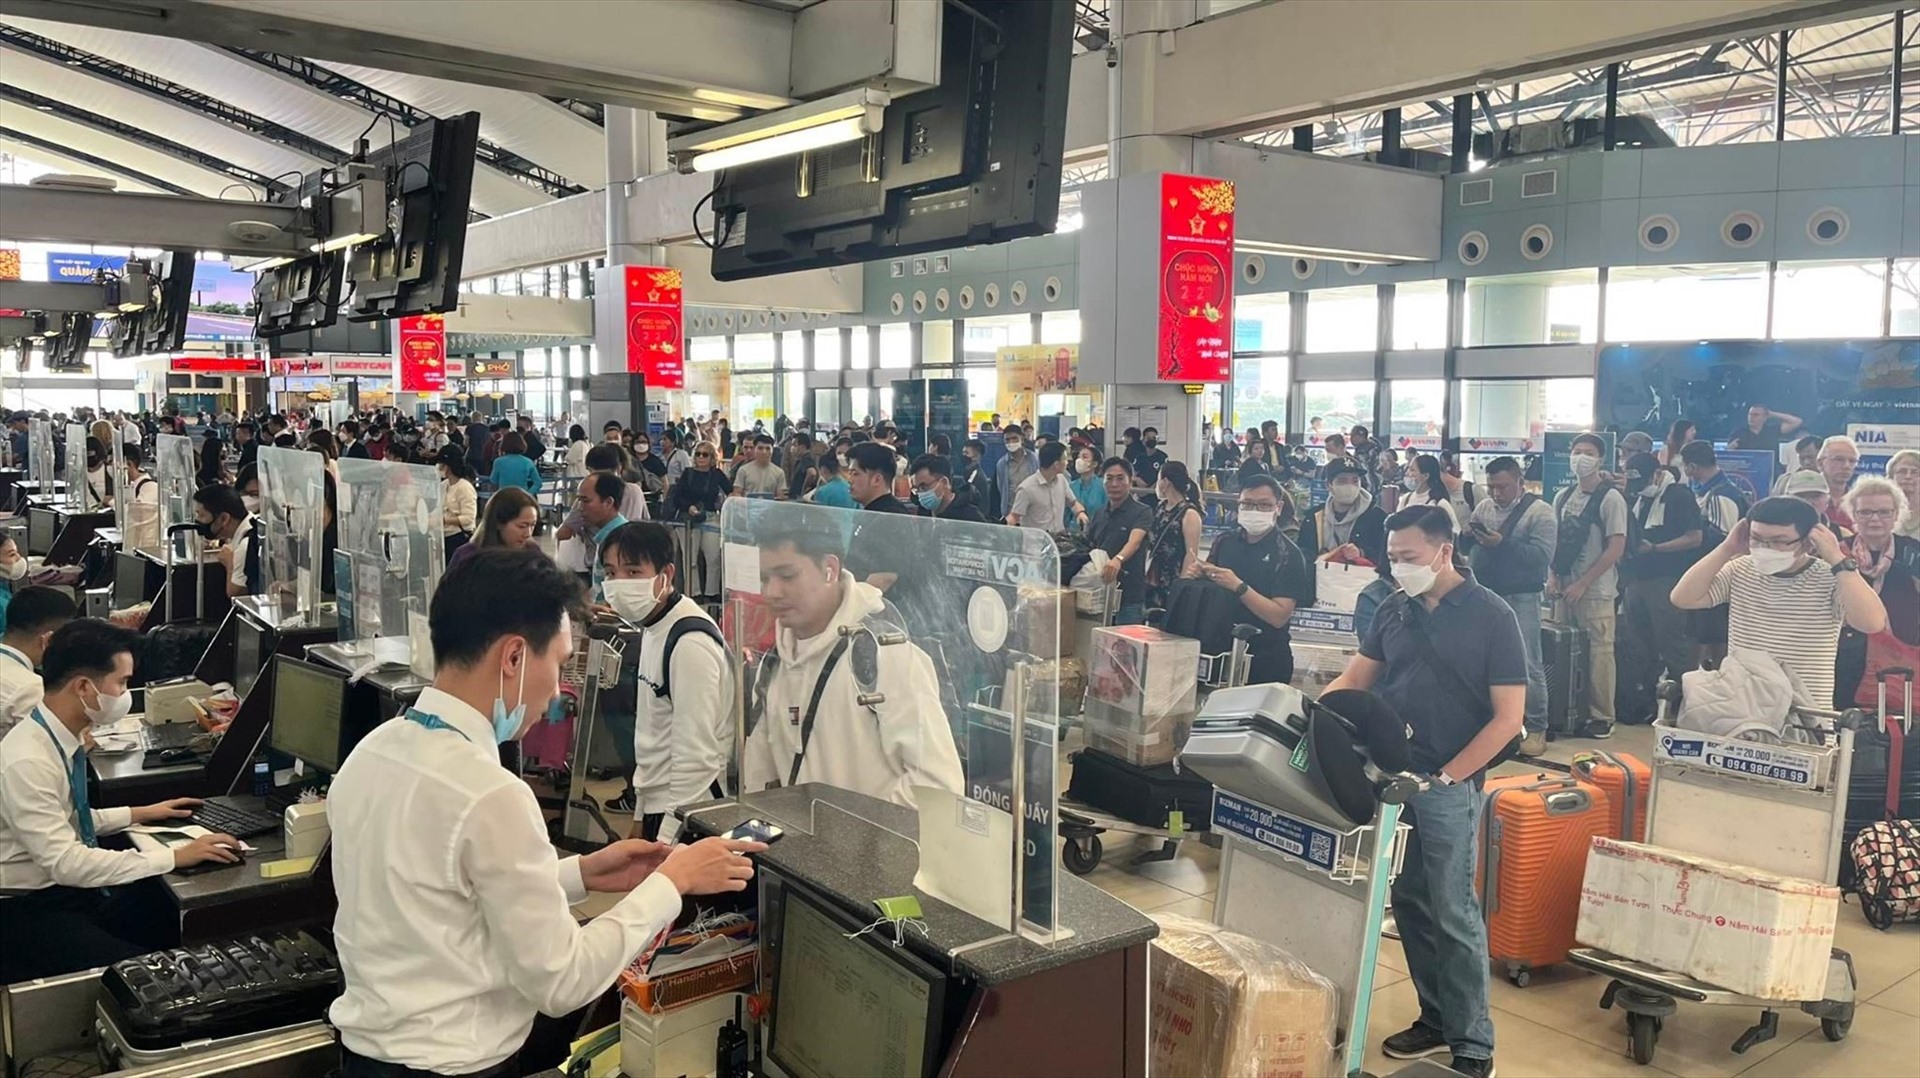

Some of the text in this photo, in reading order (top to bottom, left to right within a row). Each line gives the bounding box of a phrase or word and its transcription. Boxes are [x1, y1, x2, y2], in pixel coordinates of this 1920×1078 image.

[1855, 430, 1887, 443] NIA
[1743, 748, 1771, 761] 20.000
[973, 784, 1011, 811] ĐÓNG
[1684, 909, 1712, 924] Chung
[668, 970, 706, 987] Handle
[707, 962, 731, 976] with
